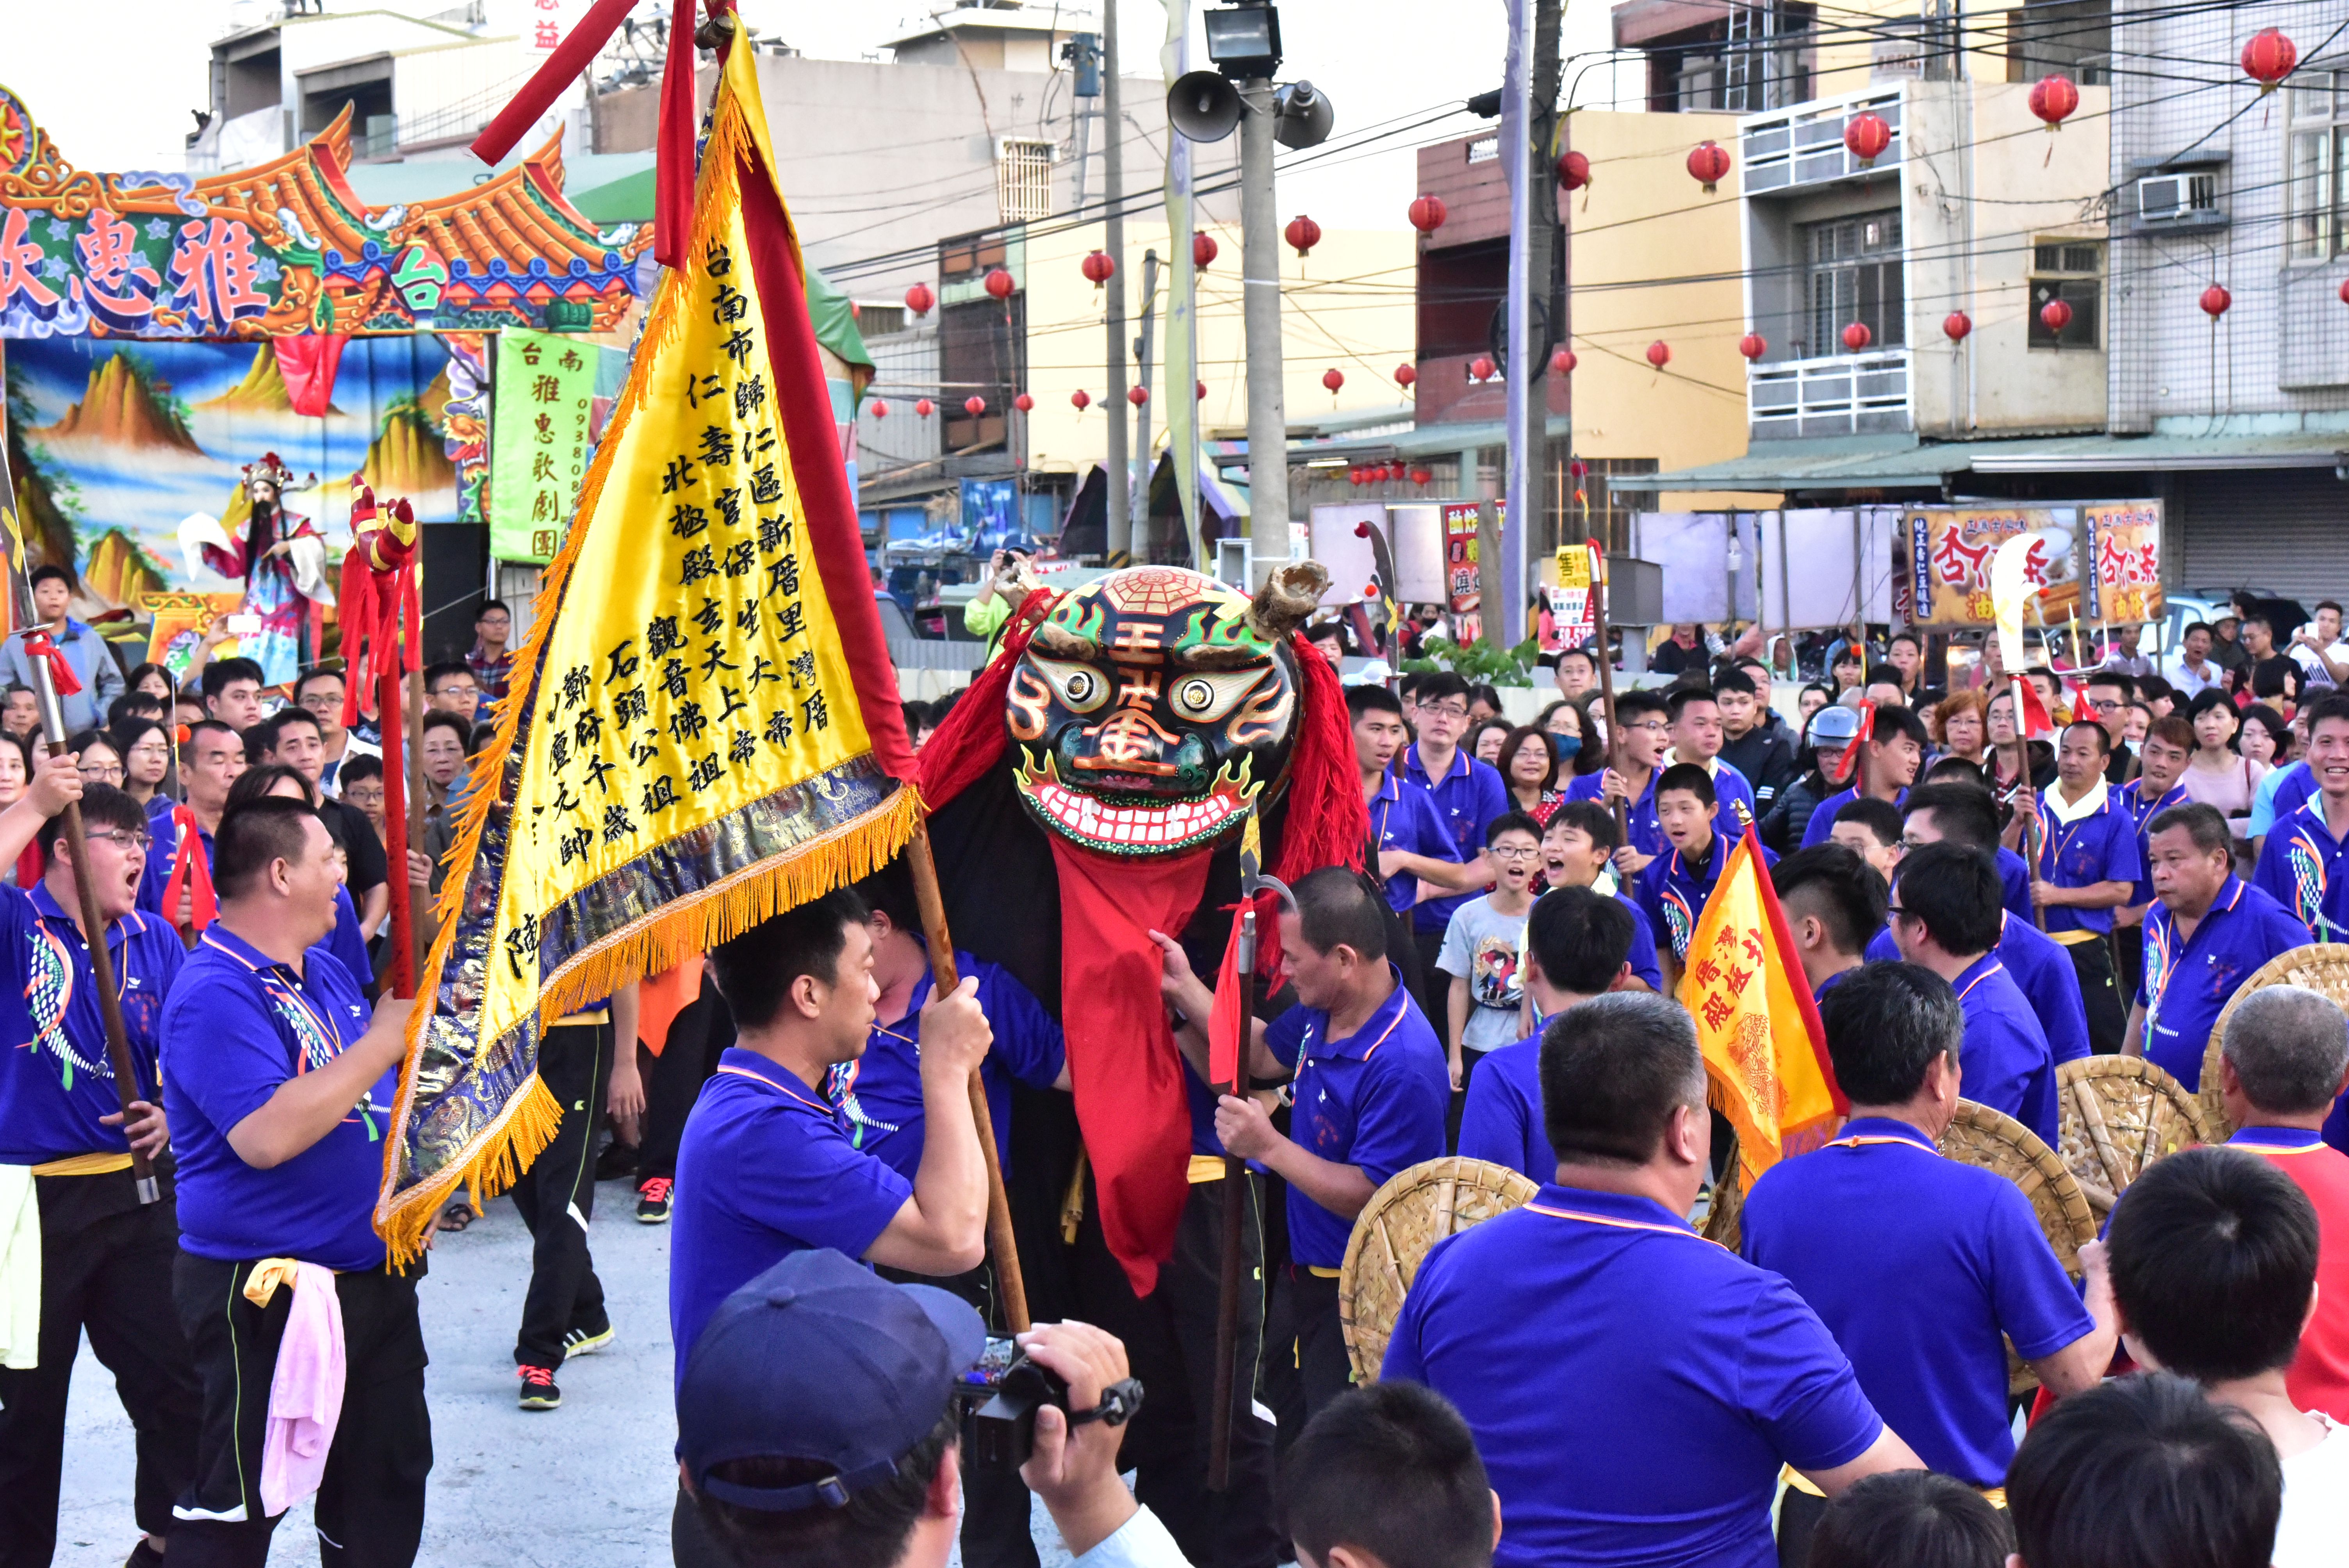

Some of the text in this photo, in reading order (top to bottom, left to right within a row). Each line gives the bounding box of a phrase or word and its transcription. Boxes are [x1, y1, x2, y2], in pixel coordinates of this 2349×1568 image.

[603, 639, 682, 815] 石頭公祖
[647, 615, 727, 793] 觀音佛祖
